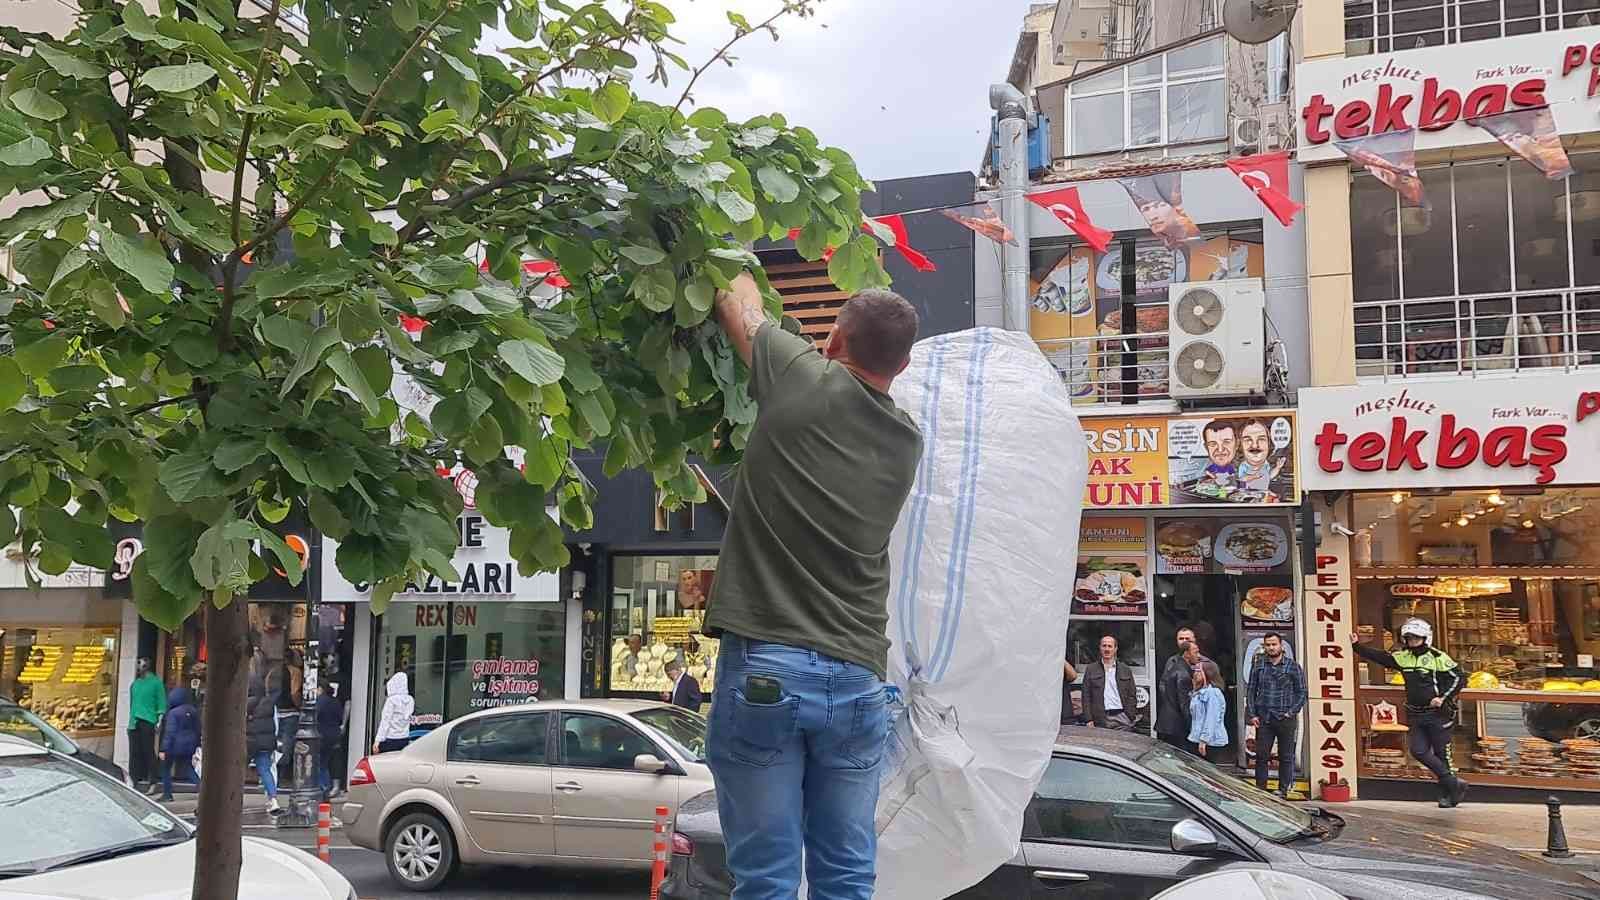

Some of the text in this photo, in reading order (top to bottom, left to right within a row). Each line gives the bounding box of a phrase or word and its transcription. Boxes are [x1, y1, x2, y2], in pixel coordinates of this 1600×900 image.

[1342, 57, 1423, 89] meşhur
[1475, 67, 1504, 80] Fark
[1355, 389, 1439, 417] meşhur
[1492, 407, 1521, 419] Fark
[1314, 414, 1568, 484] tekbaş
[416, 604, 477, 627] REXON
[472, 656, 539, 679] çınlama
[1316, 555, 1345, 784] PEYNİR HELVASI
[472, 676, 539, 697] ve işitme
